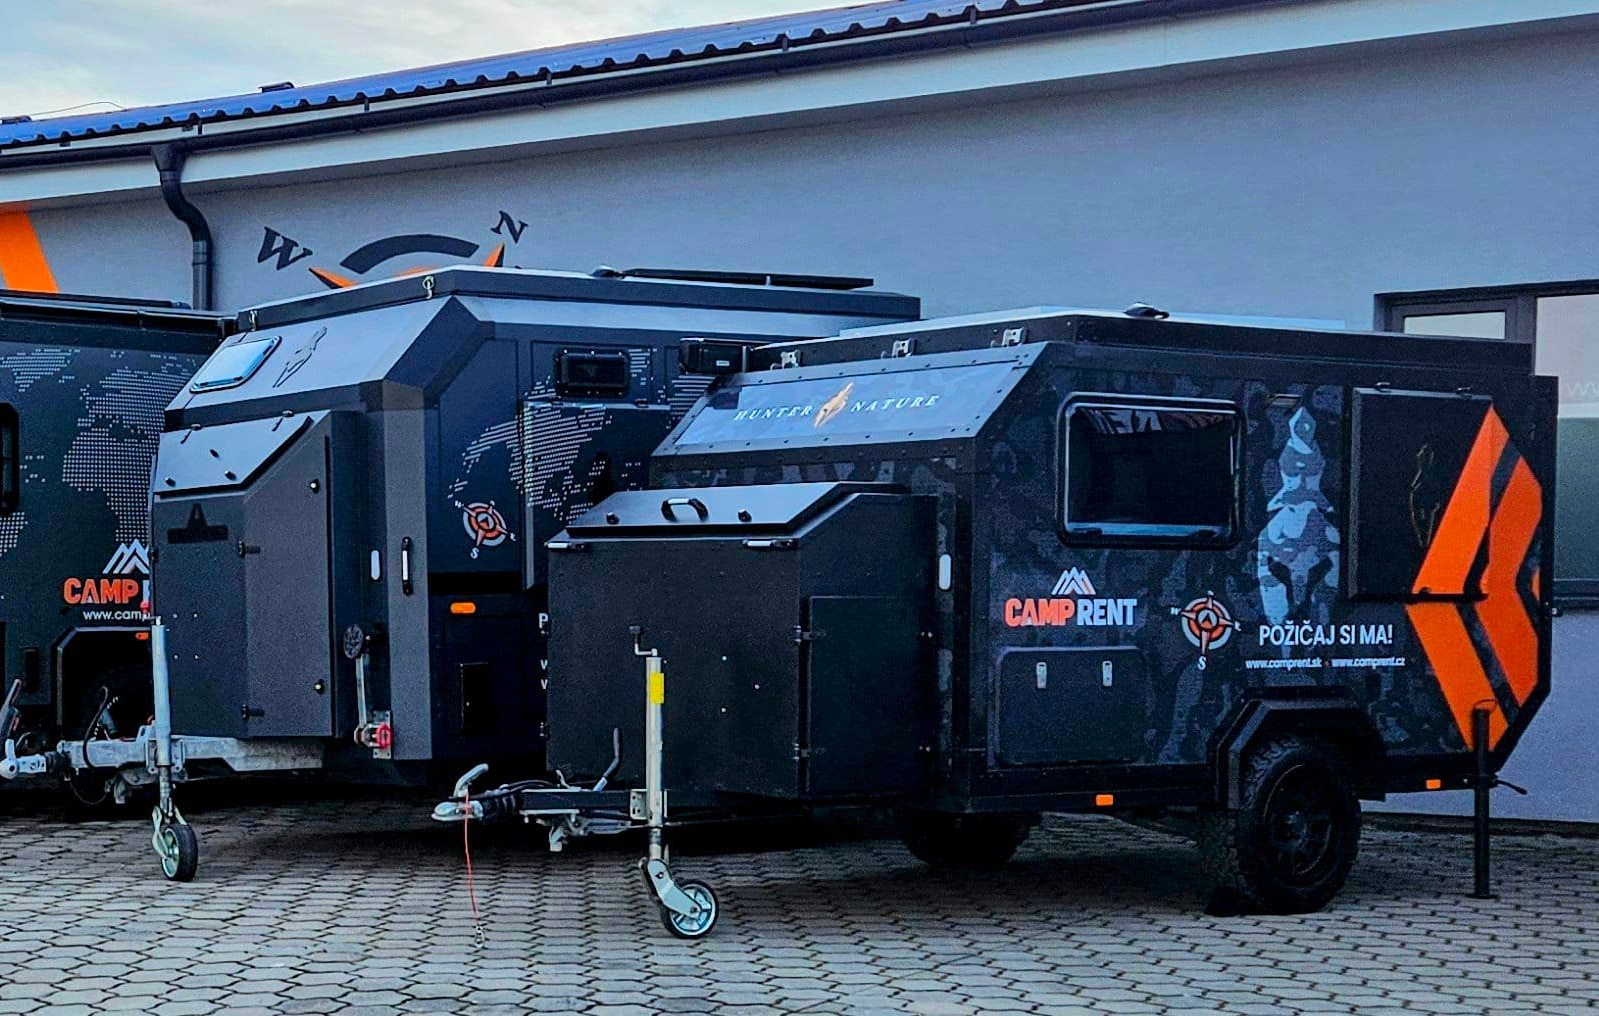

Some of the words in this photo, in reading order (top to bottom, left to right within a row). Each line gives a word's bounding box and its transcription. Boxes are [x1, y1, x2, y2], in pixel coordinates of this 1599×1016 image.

[258, 226, 313, 270] W
[733, 404, 814, 421] HUNTER
[851, 395, 941, 413] NATURE
[63, 577, 139, 604] CAMP
[1004, 598, 1075, 627] CAMP
[1077, 599, 1138, 626] RENT
[1259, 620, 1336, 646] POŽIČAJ
[1339, 625, 1355, 645] SI
[1359, 624, 1393, 644] MA!
[1197, 656, 1206, 671] S
